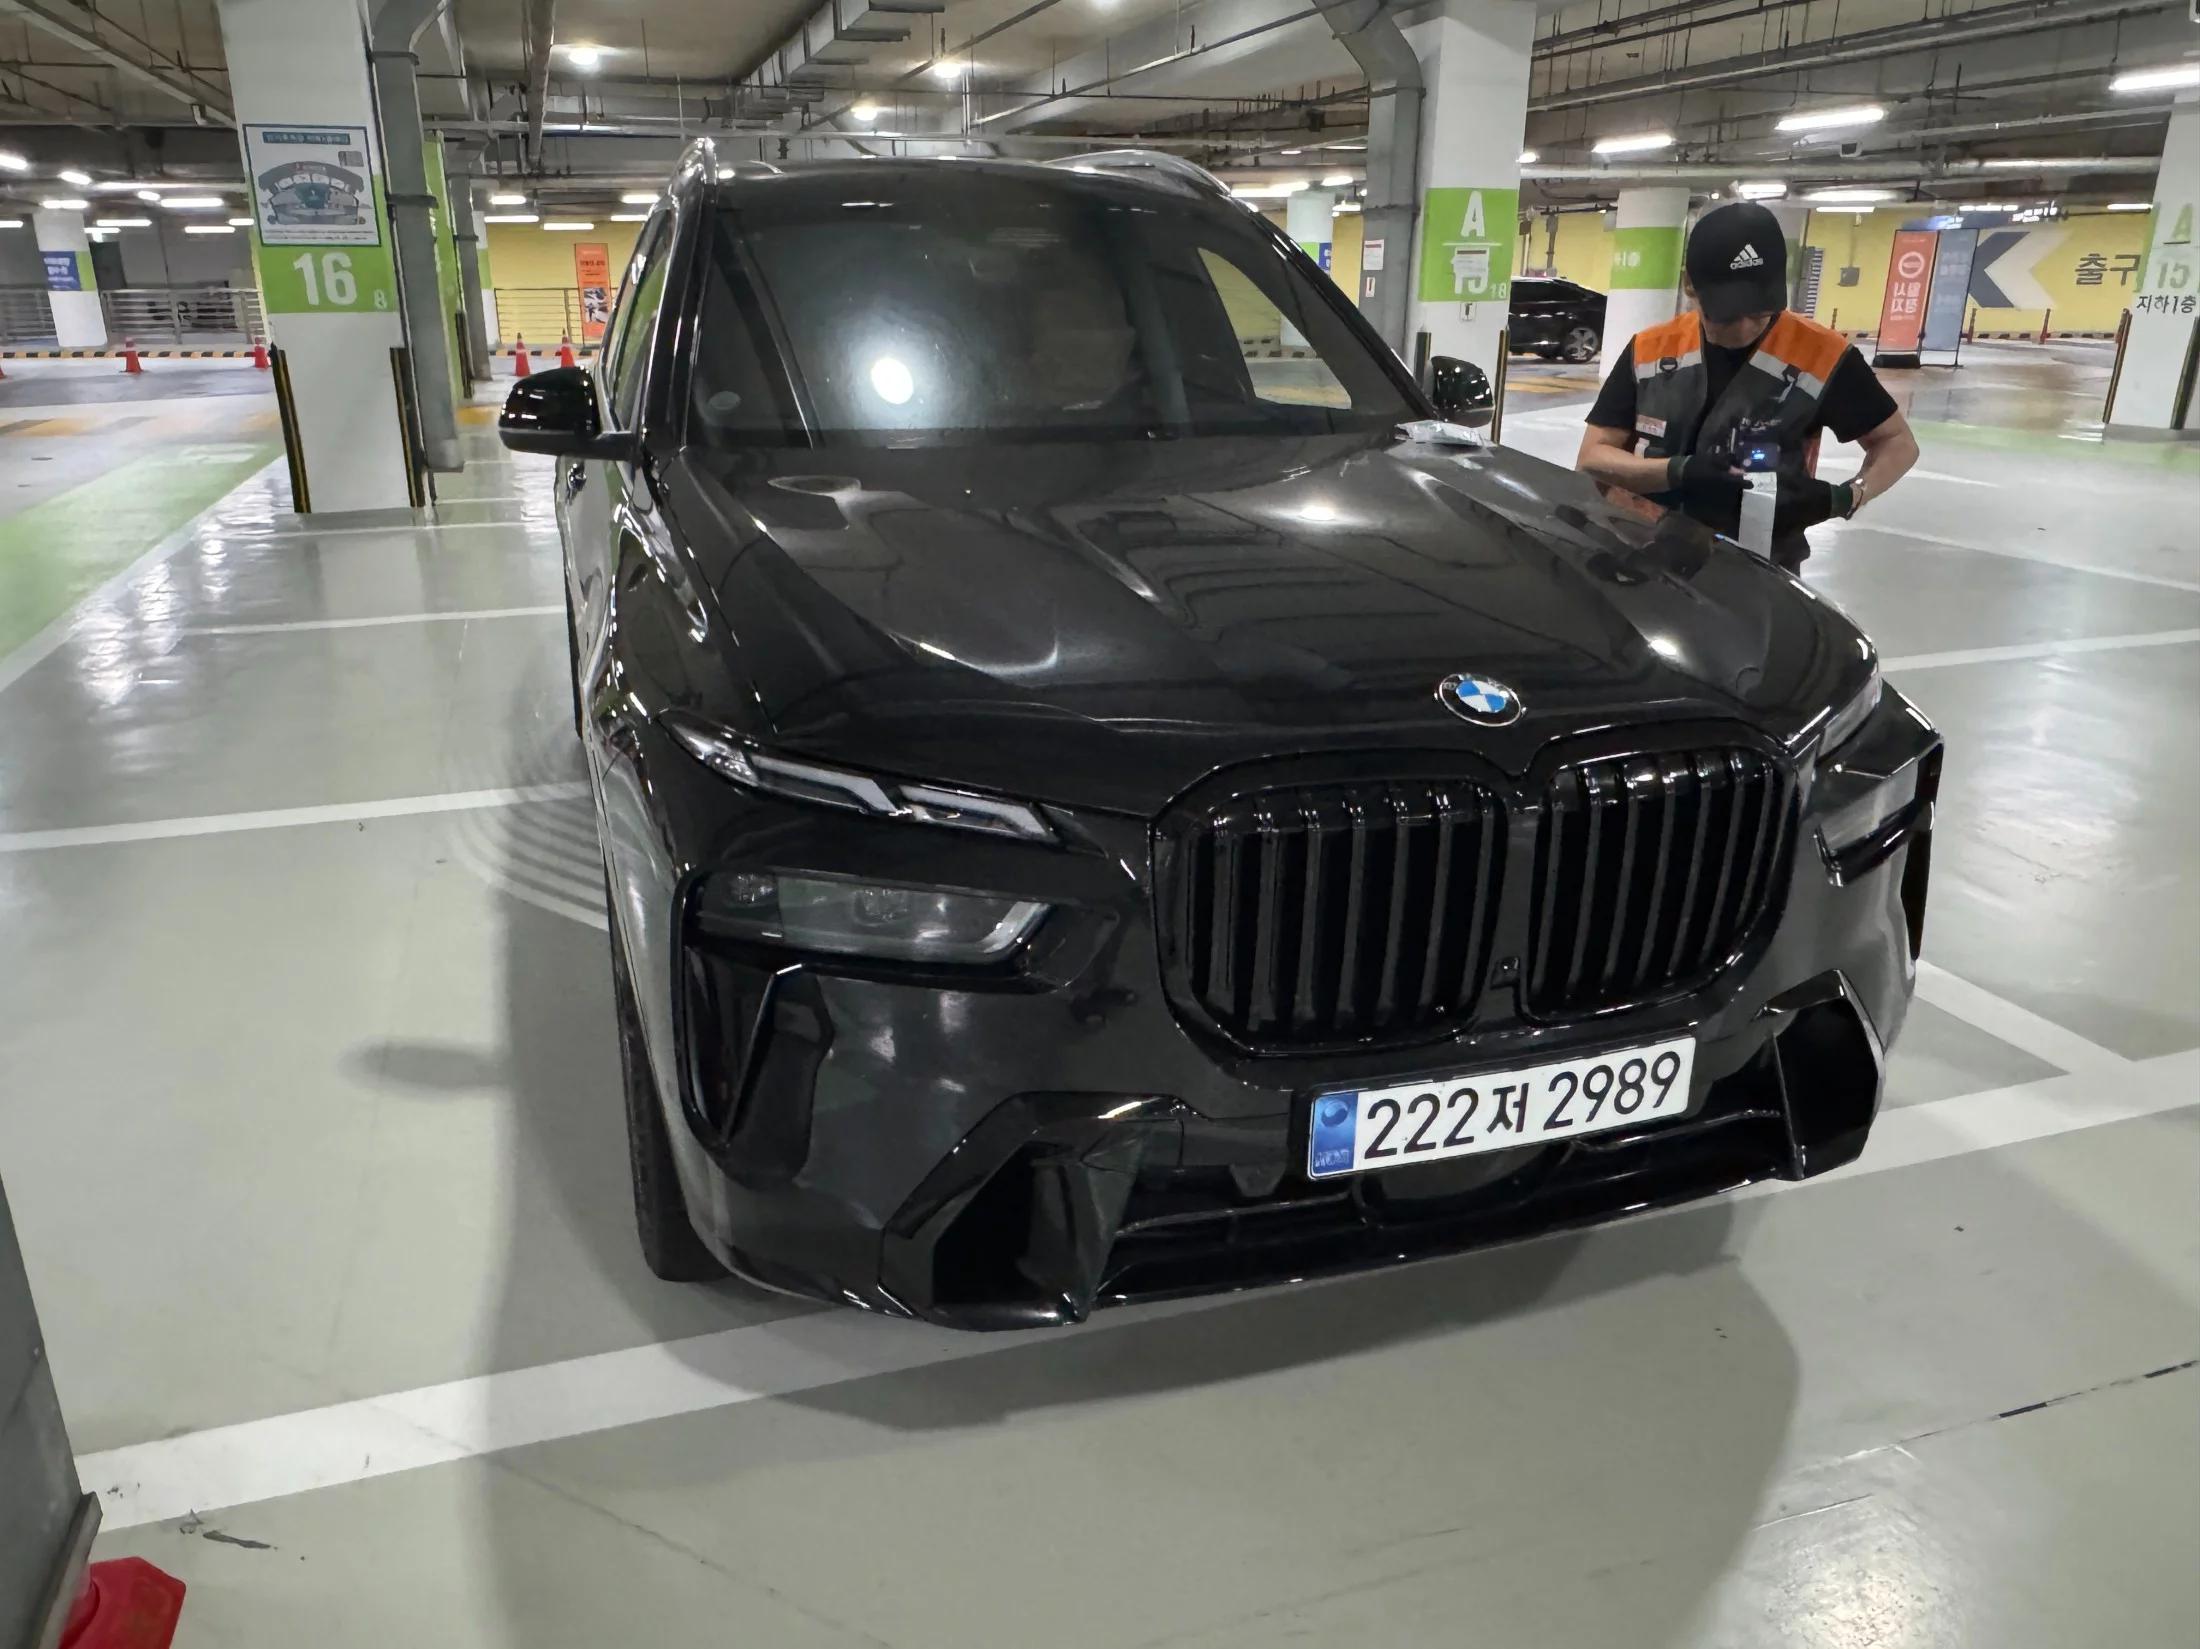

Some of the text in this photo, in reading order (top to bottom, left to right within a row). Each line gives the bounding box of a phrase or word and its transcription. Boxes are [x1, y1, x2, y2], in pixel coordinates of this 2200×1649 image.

[1461, 190, 1485, 237] A
[294, 252, 358, 306] 16
[2074, 252, 2141, 287] 출구
[2157, 261, 2191, 289] 15
[2136, 294, 2197, 316] 지하1층
[1543, 1050, 1681, 1131] 2989
